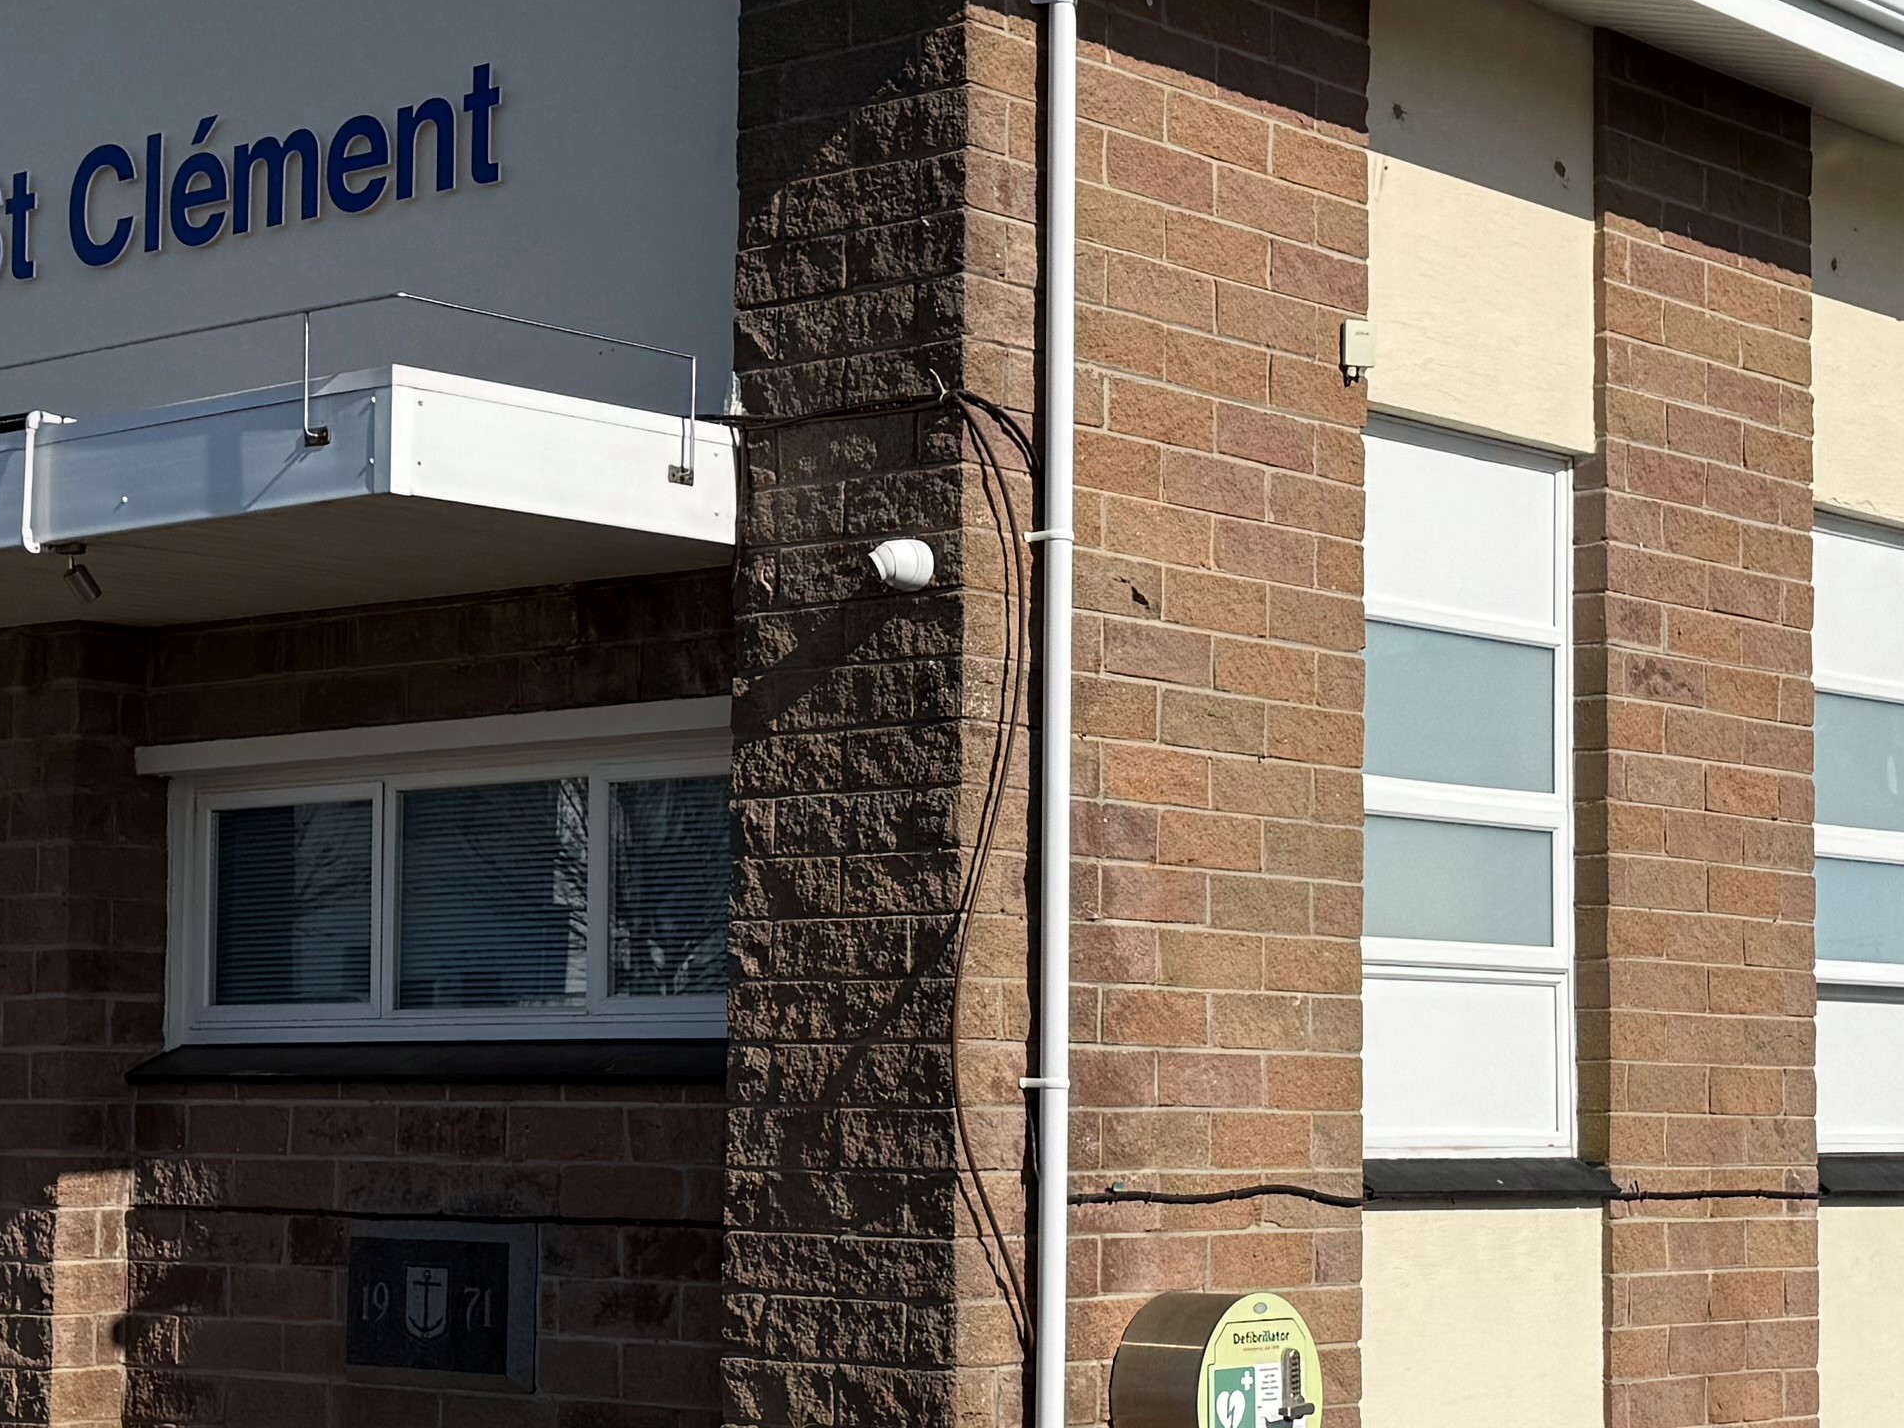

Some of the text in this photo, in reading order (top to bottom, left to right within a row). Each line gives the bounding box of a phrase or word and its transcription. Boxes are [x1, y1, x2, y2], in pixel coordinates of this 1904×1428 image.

[70, 63, 501, 266] Clément
[361, 1281, 493, 1332] 19 71
[1233, 1330, 1290, 1344] Defibrillator
